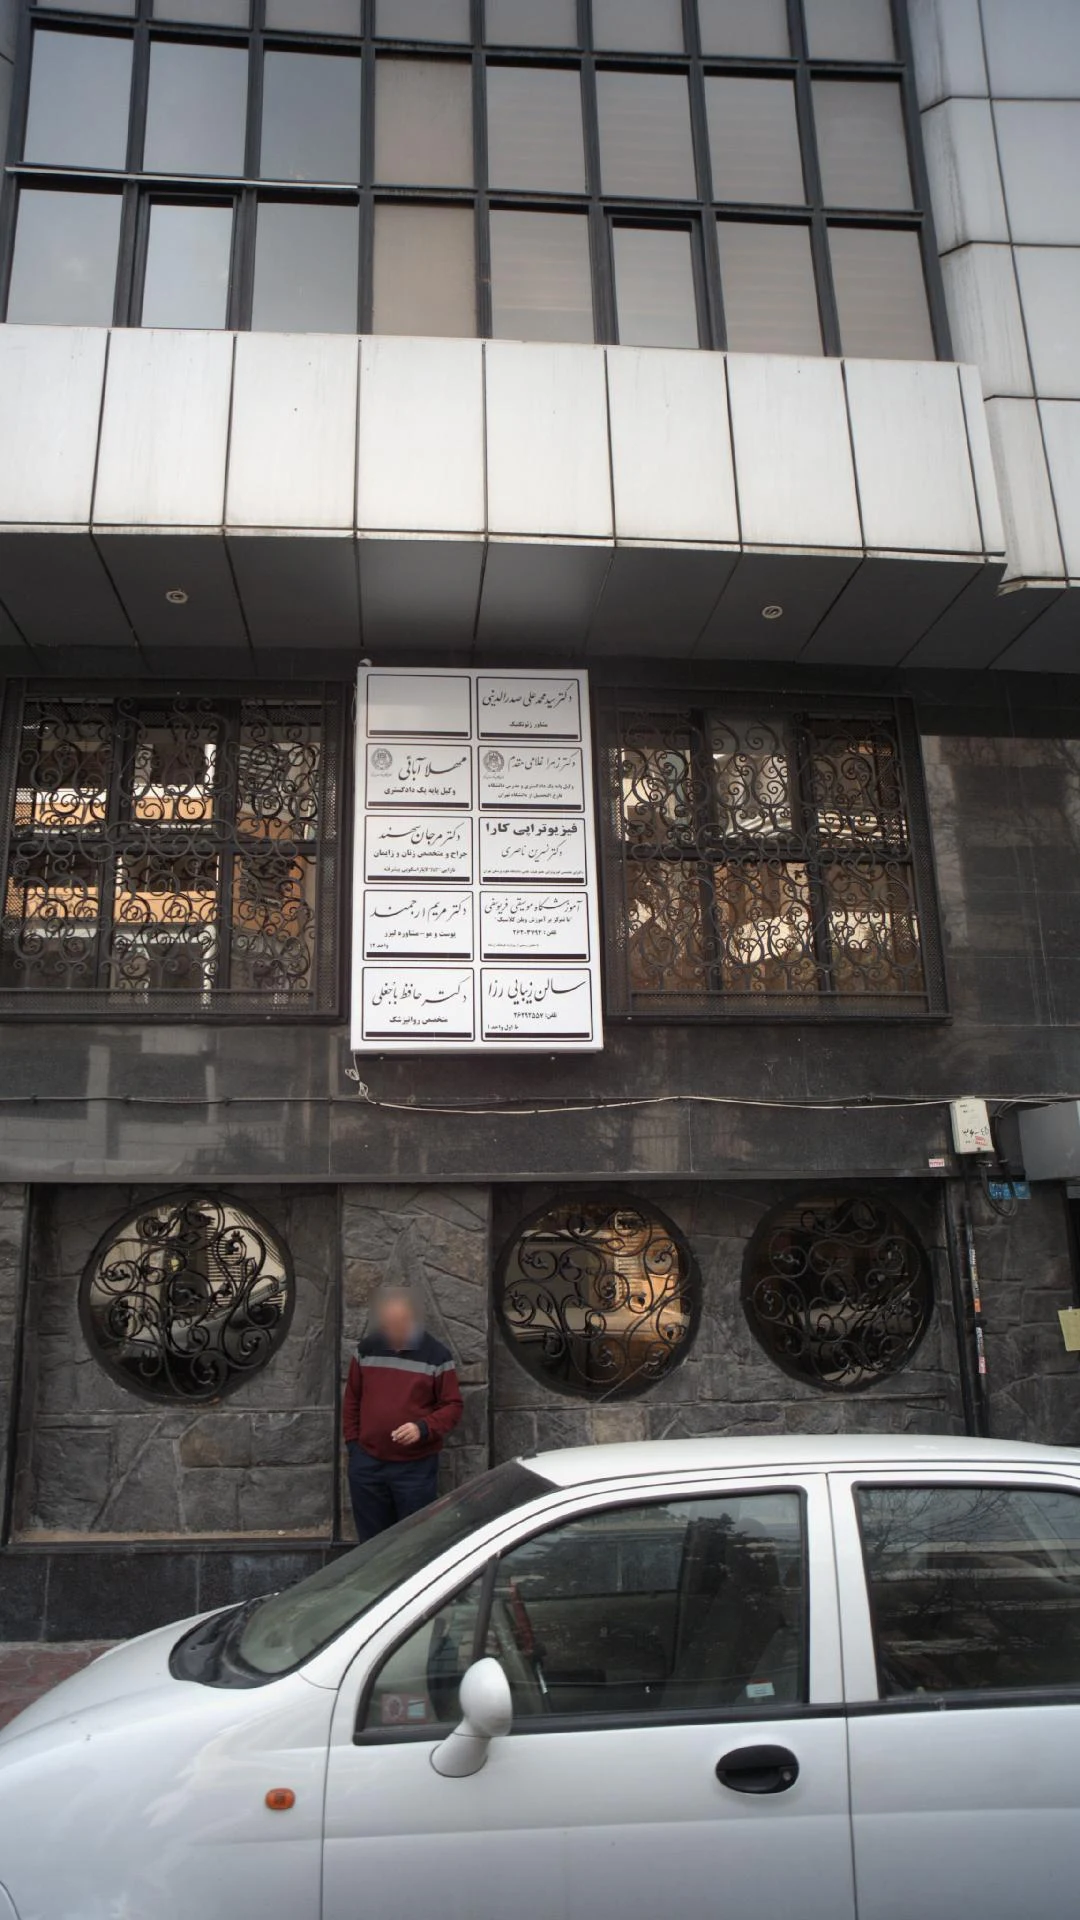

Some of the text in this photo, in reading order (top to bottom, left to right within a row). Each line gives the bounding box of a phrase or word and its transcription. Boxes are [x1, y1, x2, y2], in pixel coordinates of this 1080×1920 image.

[553, 682, 575, 709] دکتر
[559, 750, 580, 772] دکتر
[383, 786, 456, 796] وکیل پایه یک دادگستری
[440, 822, 465, 846] دکتر
[486, 822, 578, 836] فیزیوتراپی کارا
[373, 849, 395, 858] زایمان
[401, 849, 416, 858] زنان
[417, 849, 443, 858] متخصص
[450, 850, 467, 859] جراح
[547, 839, 567, 862] دکتر
[370, 895, 471, 923] دکتر مریم ارجمند
[384, 929, 396, 937] لیزر
[398, 929, 419, 938] مشاوره
[439, 930, 456, 938] پوست
[400, 983, 422, 1000] حافظ
[421, 976, 471, 1007] دکتر
[507, 978, 533, 1005] زیبایی
[534, 978, 587, 1002] سالن
[422, 1016, 448, 1025] متخصص
